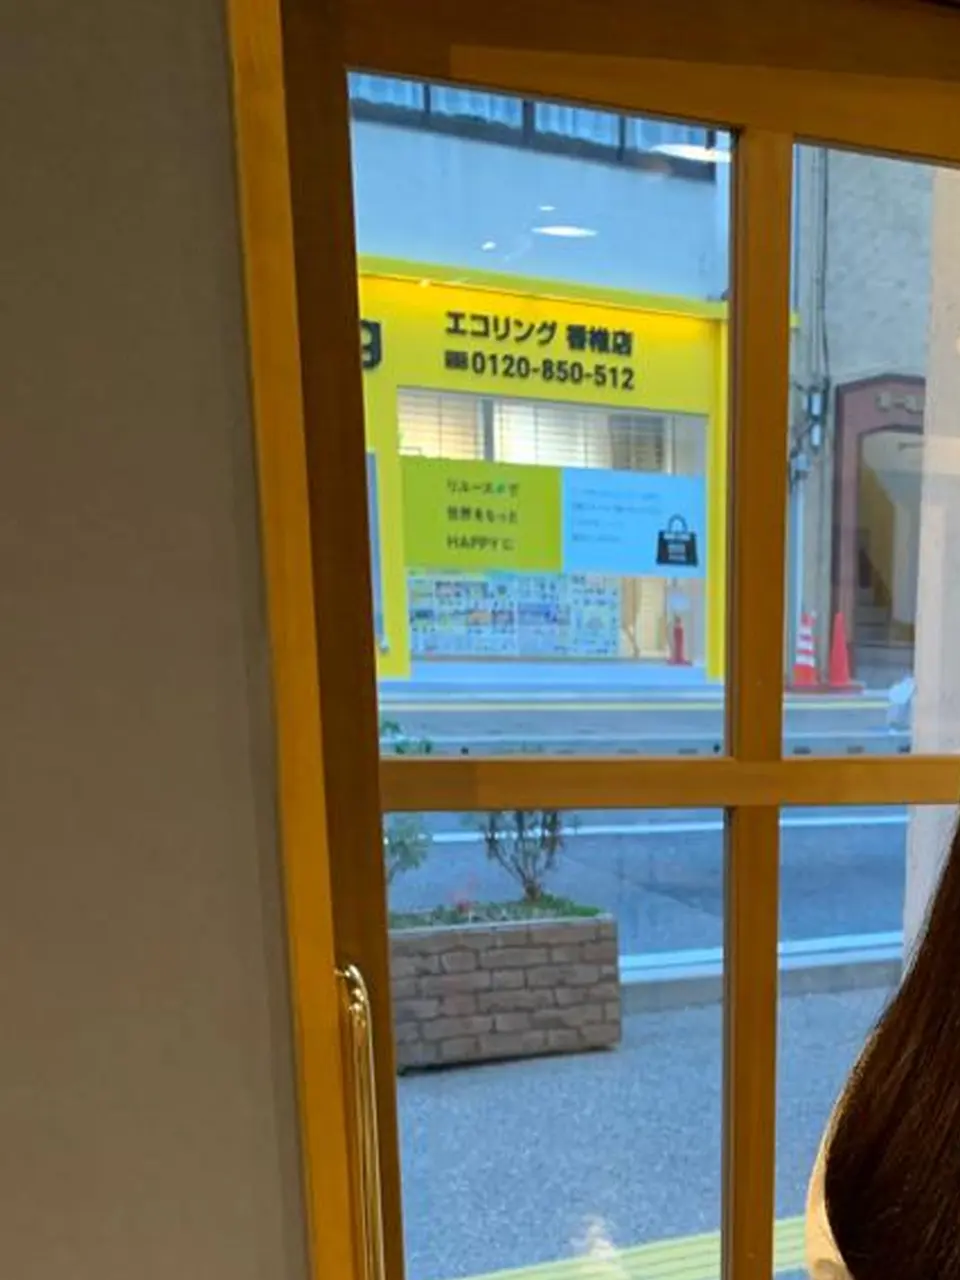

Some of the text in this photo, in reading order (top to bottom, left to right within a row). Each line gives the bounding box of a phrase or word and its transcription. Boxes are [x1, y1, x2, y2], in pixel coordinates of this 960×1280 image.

[445, 311, 558, 346] エコリング
[472, 352, 635, 390] 0120-850-512
